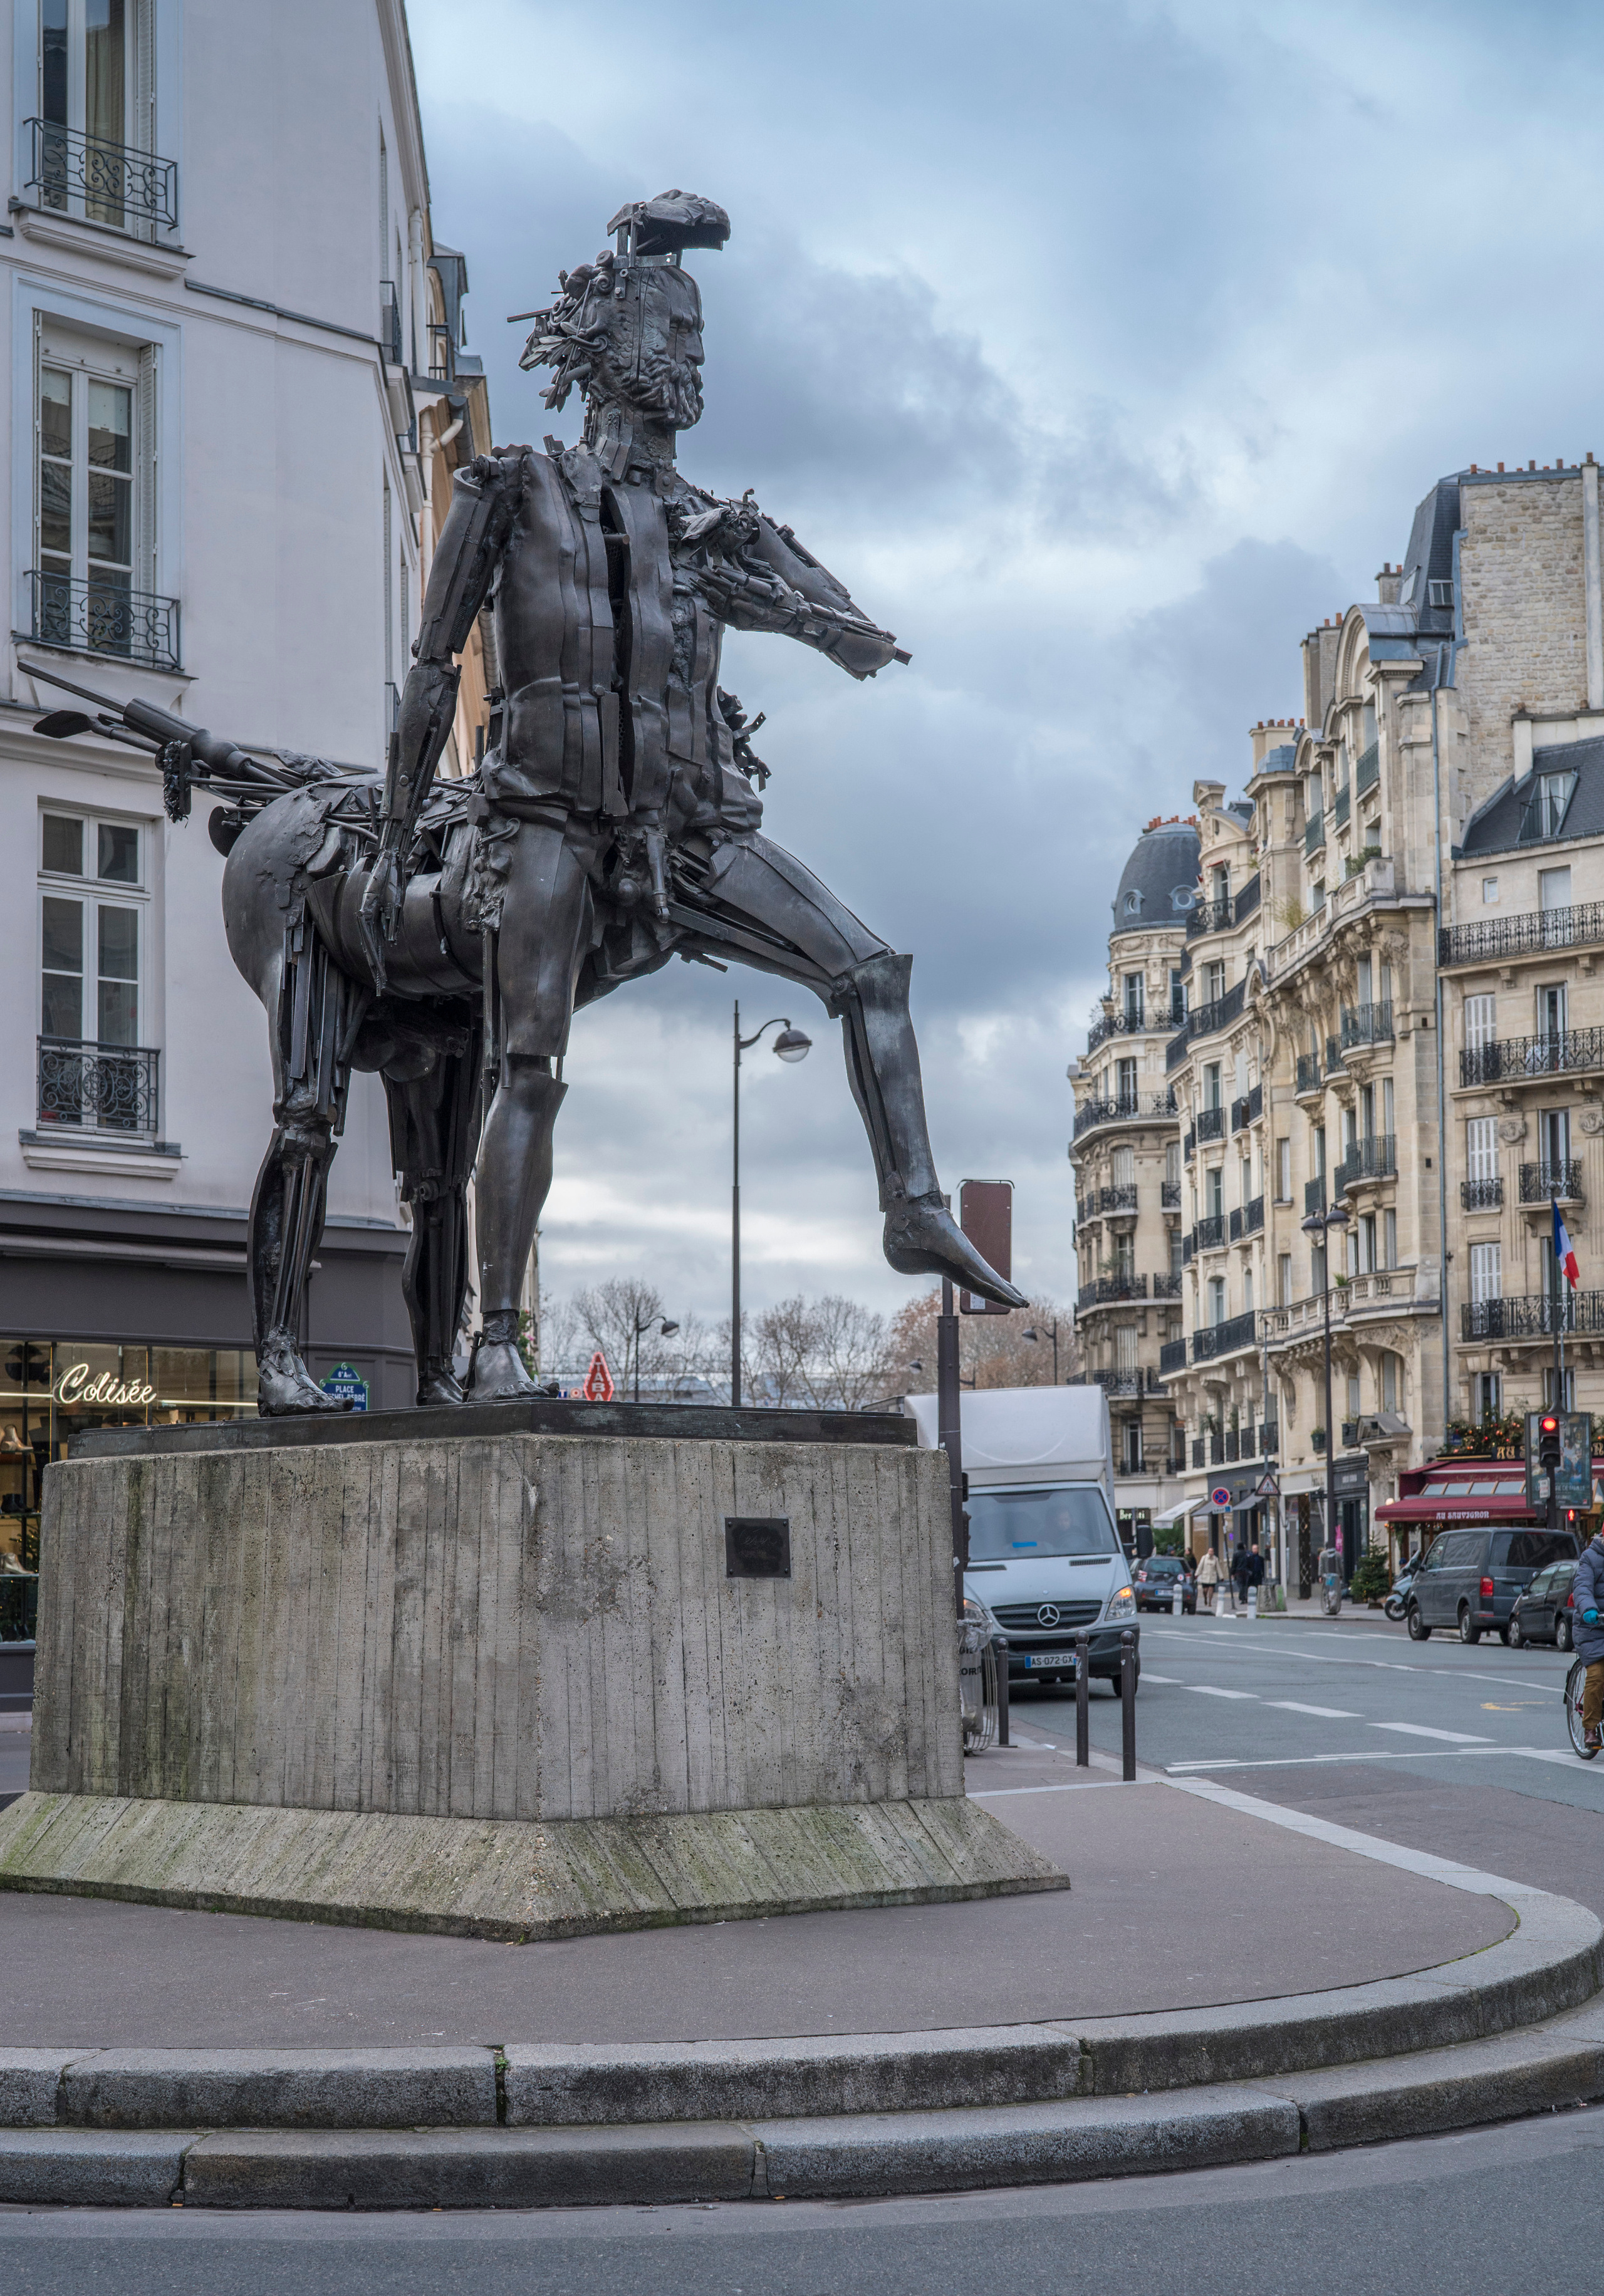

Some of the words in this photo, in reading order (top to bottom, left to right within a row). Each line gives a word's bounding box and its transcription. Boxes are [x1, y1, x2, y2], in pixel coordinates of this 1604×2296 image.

[60, 1363, 157, 1404] Colisée
[335, 1384, 355, 1394] PLACE
[1497, 1445, 1516, 1460] AU
[1120, 1509, 1145, 1520] Berti
[1436, 1512, 1446, 1520] AU
[1447, 1510, 1489, 1519] SAUVIGNON
